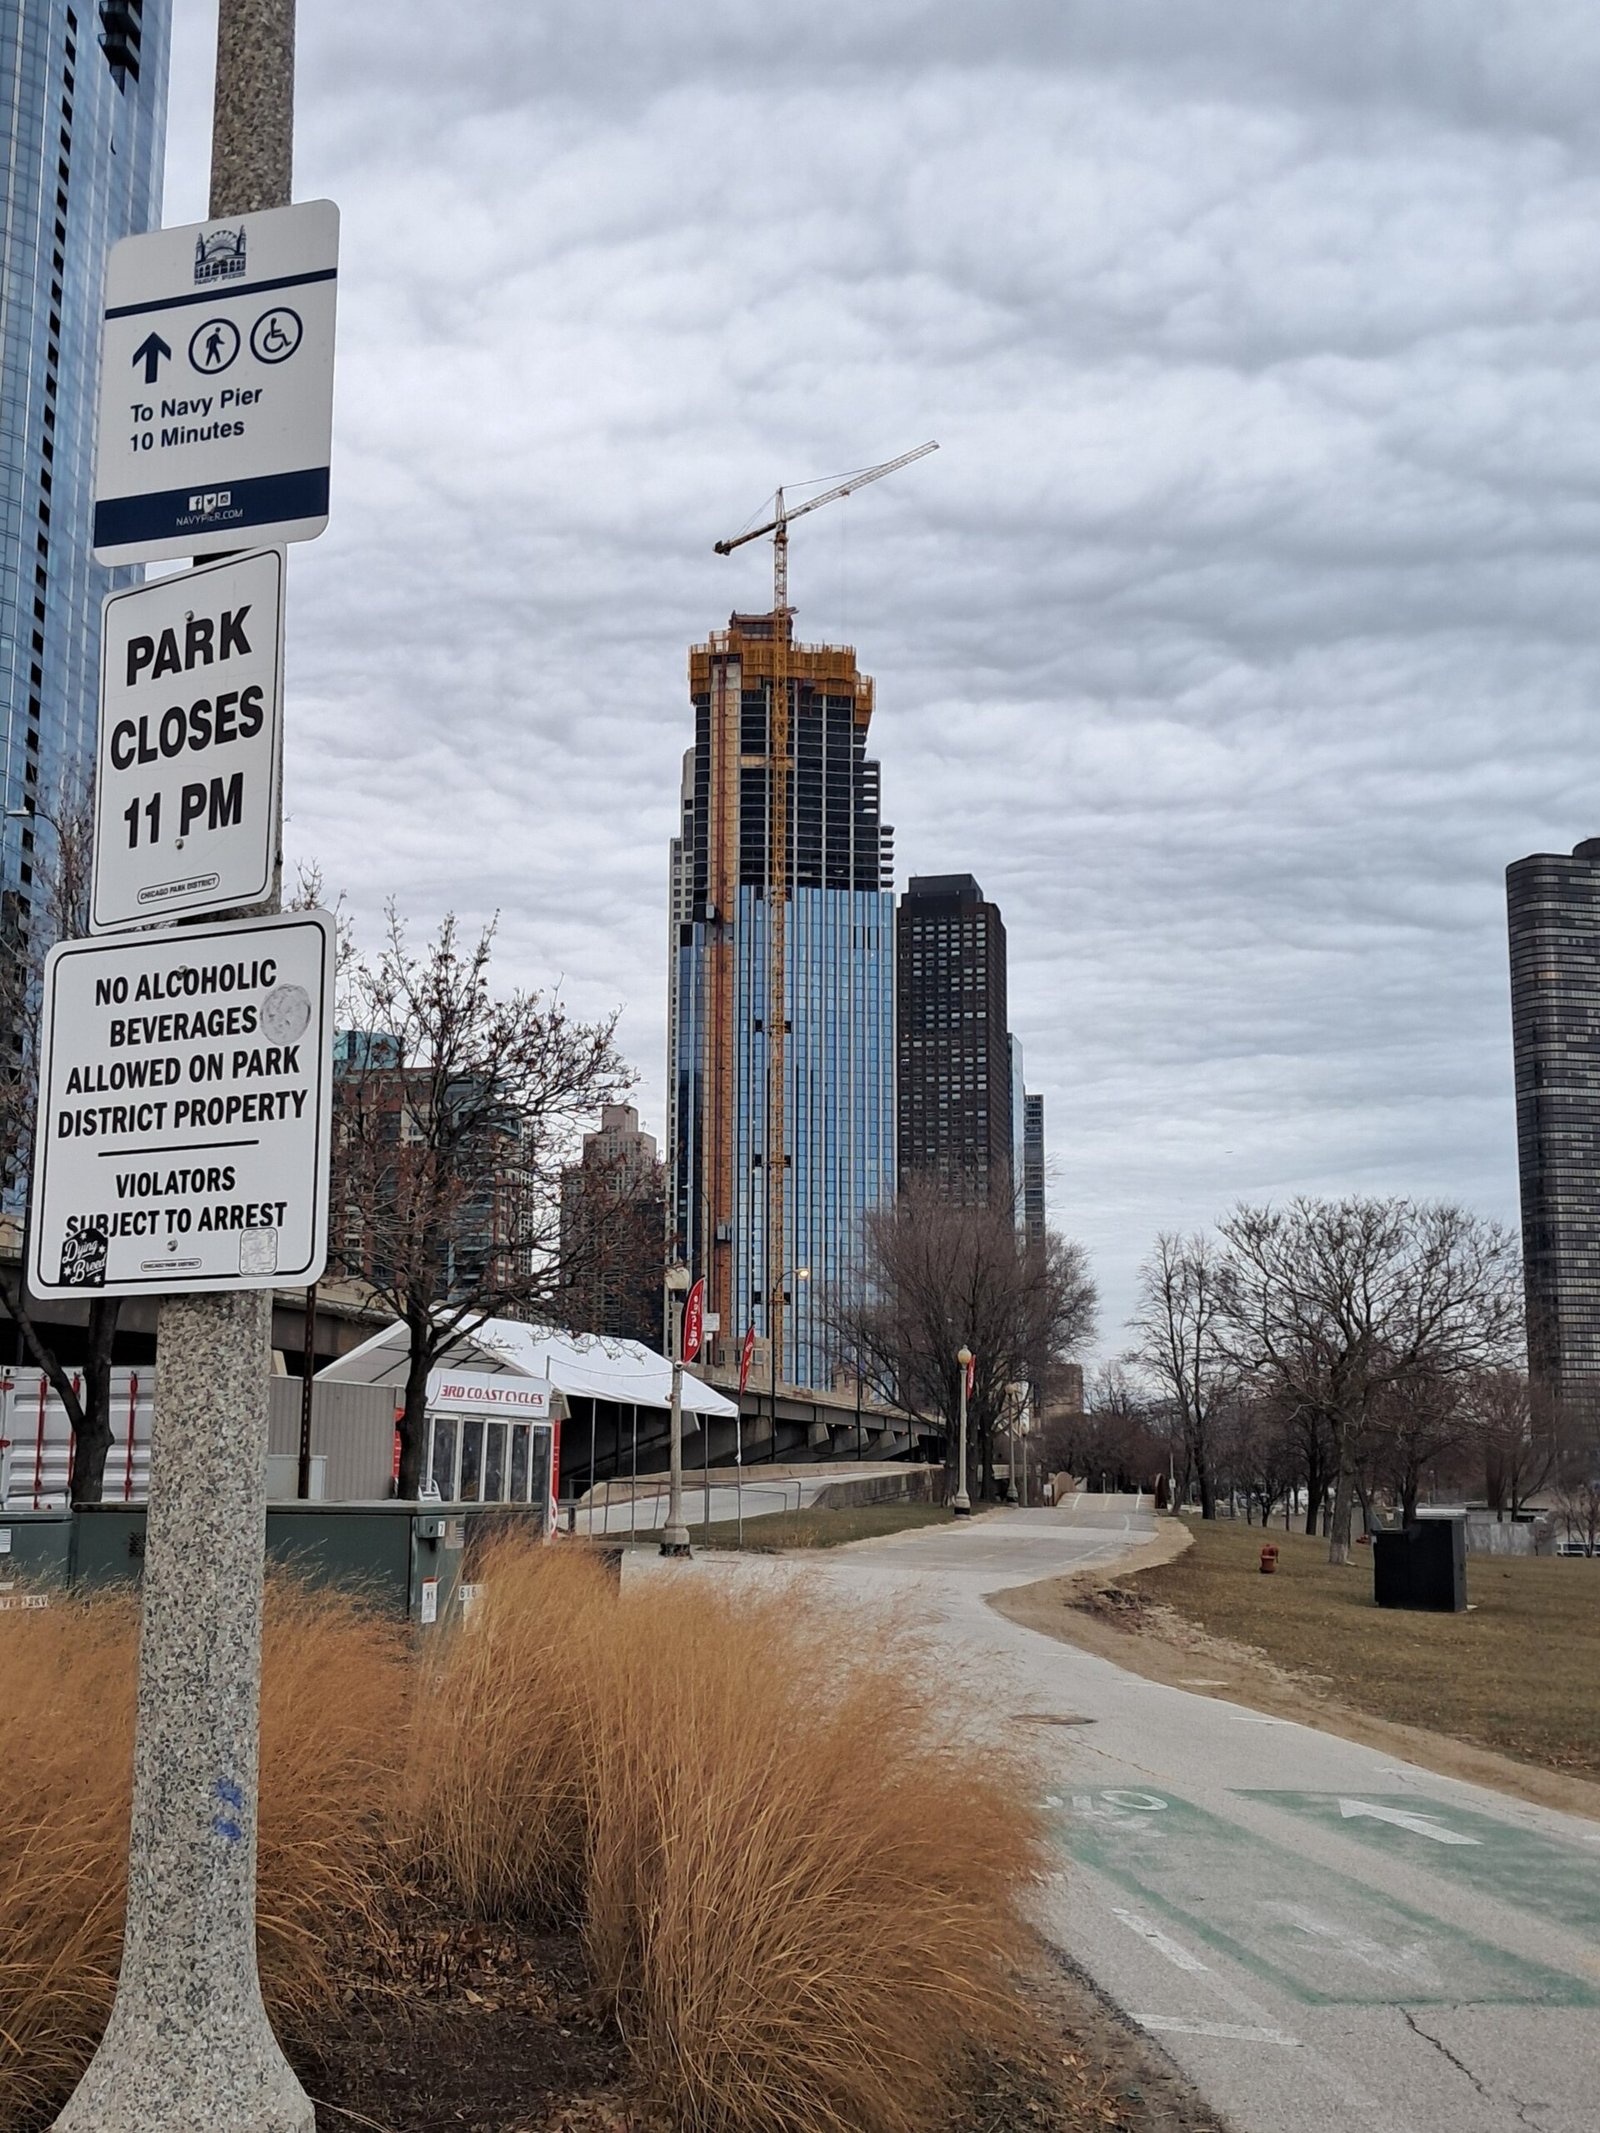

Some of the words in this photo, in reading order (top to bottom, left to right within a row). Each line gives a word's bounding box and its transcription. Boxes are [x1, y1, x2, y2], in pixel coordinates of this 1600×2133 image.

[130, 403, 154, 423] To
[161, 398, 213, 418] Navy
[220, 388, 263, 409] Pier
[130, 432, 154, 452] 10
[161, 420, 245, 448] Minutes
[126, 604, 252, 687] PARK
[110, 685, 264, 771] CLOSES
[124, 792, 161, 849] 11
[179, 771, 244, 837] PM
[140, 887, 169, 900] CHICAGO
[170, 883, 186, 894] PARK
[187, 877, 217, 890] DISTRICT
[95, 976, 129, 1006] NO
[135, 958, 277, 1002] ALCOHOLIC
[110, 1005, 257, 1048] BEVERAGES
[66, 1058, 181, 1095] ALLOWED
[189, 1053, 224, 1083] ON
[233, 1045, 300, 1079] PARK
[58, 1101, 168, 1139] DISTRICT
[174, 1089, 308, 1129] PROPERTY
[115, 1166, 236, 1199] VIOLATORS
[65, 1210, 160, 1238] SUBJECT
[164, 1208, 192, 1234] TO
[197, 1201, 288, 1232] ARREST
[62, 1239, 98, 1264] Dying
[440, 1384, 465, 1398] 3RD
[467, 1386, 505, 1401] COAST
[505, 1390, 544, 1405] CYCLES
